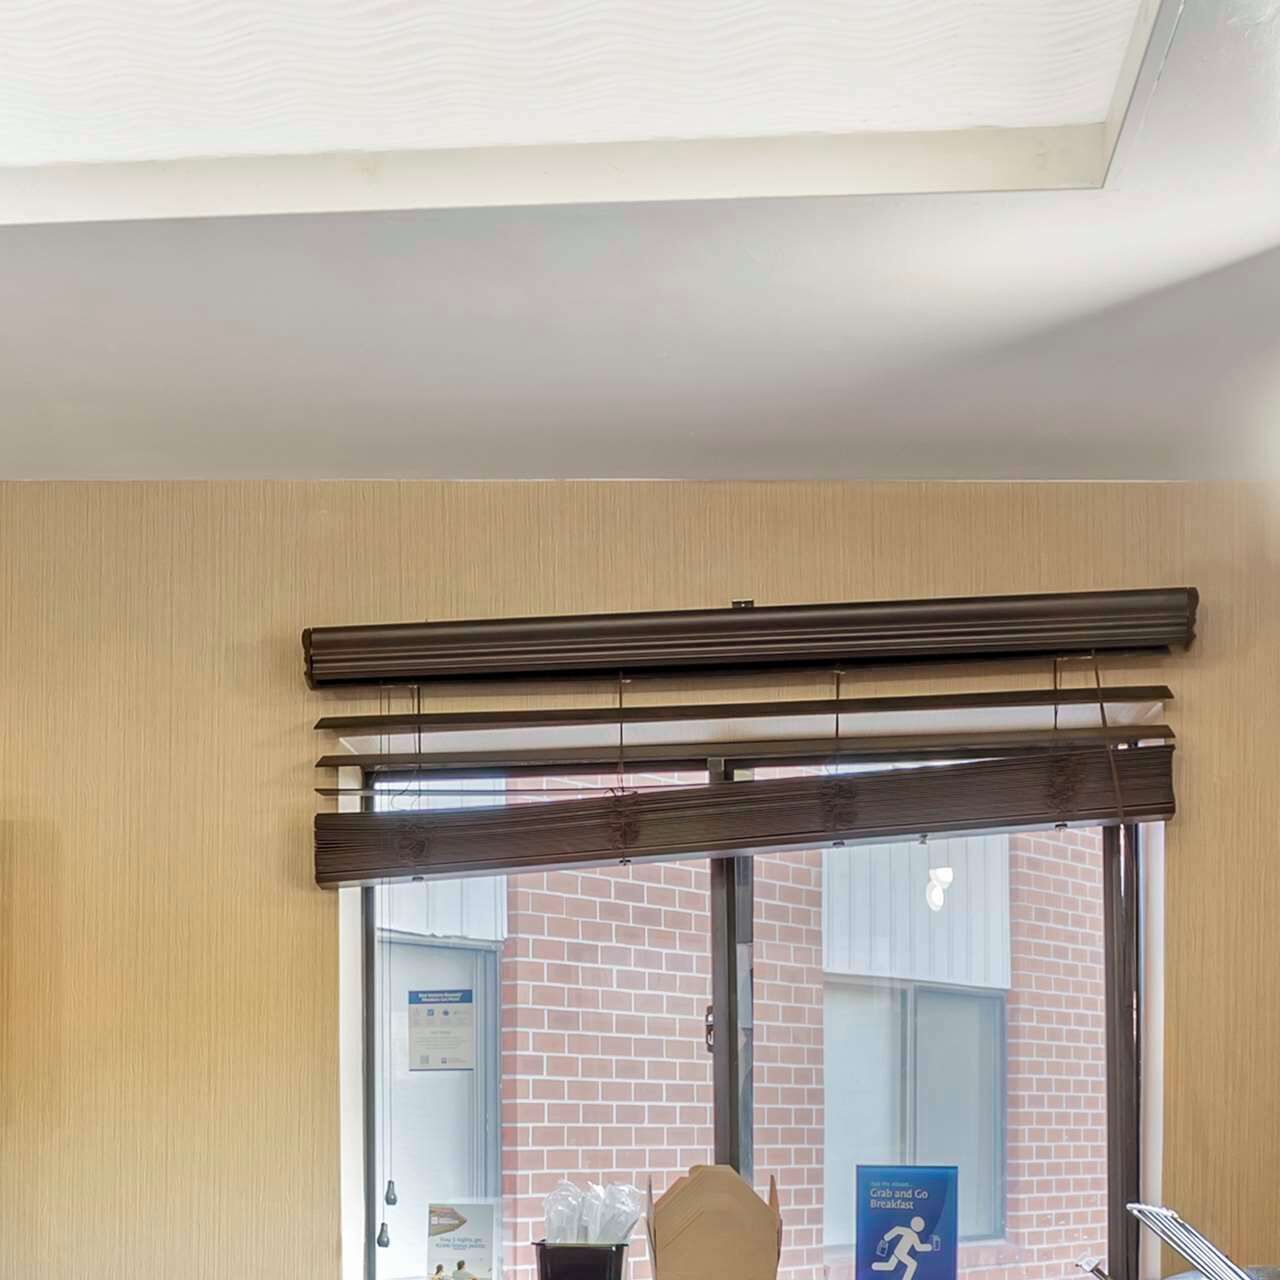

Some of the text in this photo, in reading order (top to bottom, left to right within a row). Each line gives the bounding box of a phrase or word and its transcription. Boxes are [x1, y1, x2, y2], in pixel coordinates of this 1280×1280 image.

[870, 1188, 929, 1200] Grab and Go
[870, 1199, 914, 1210] Breakfast
